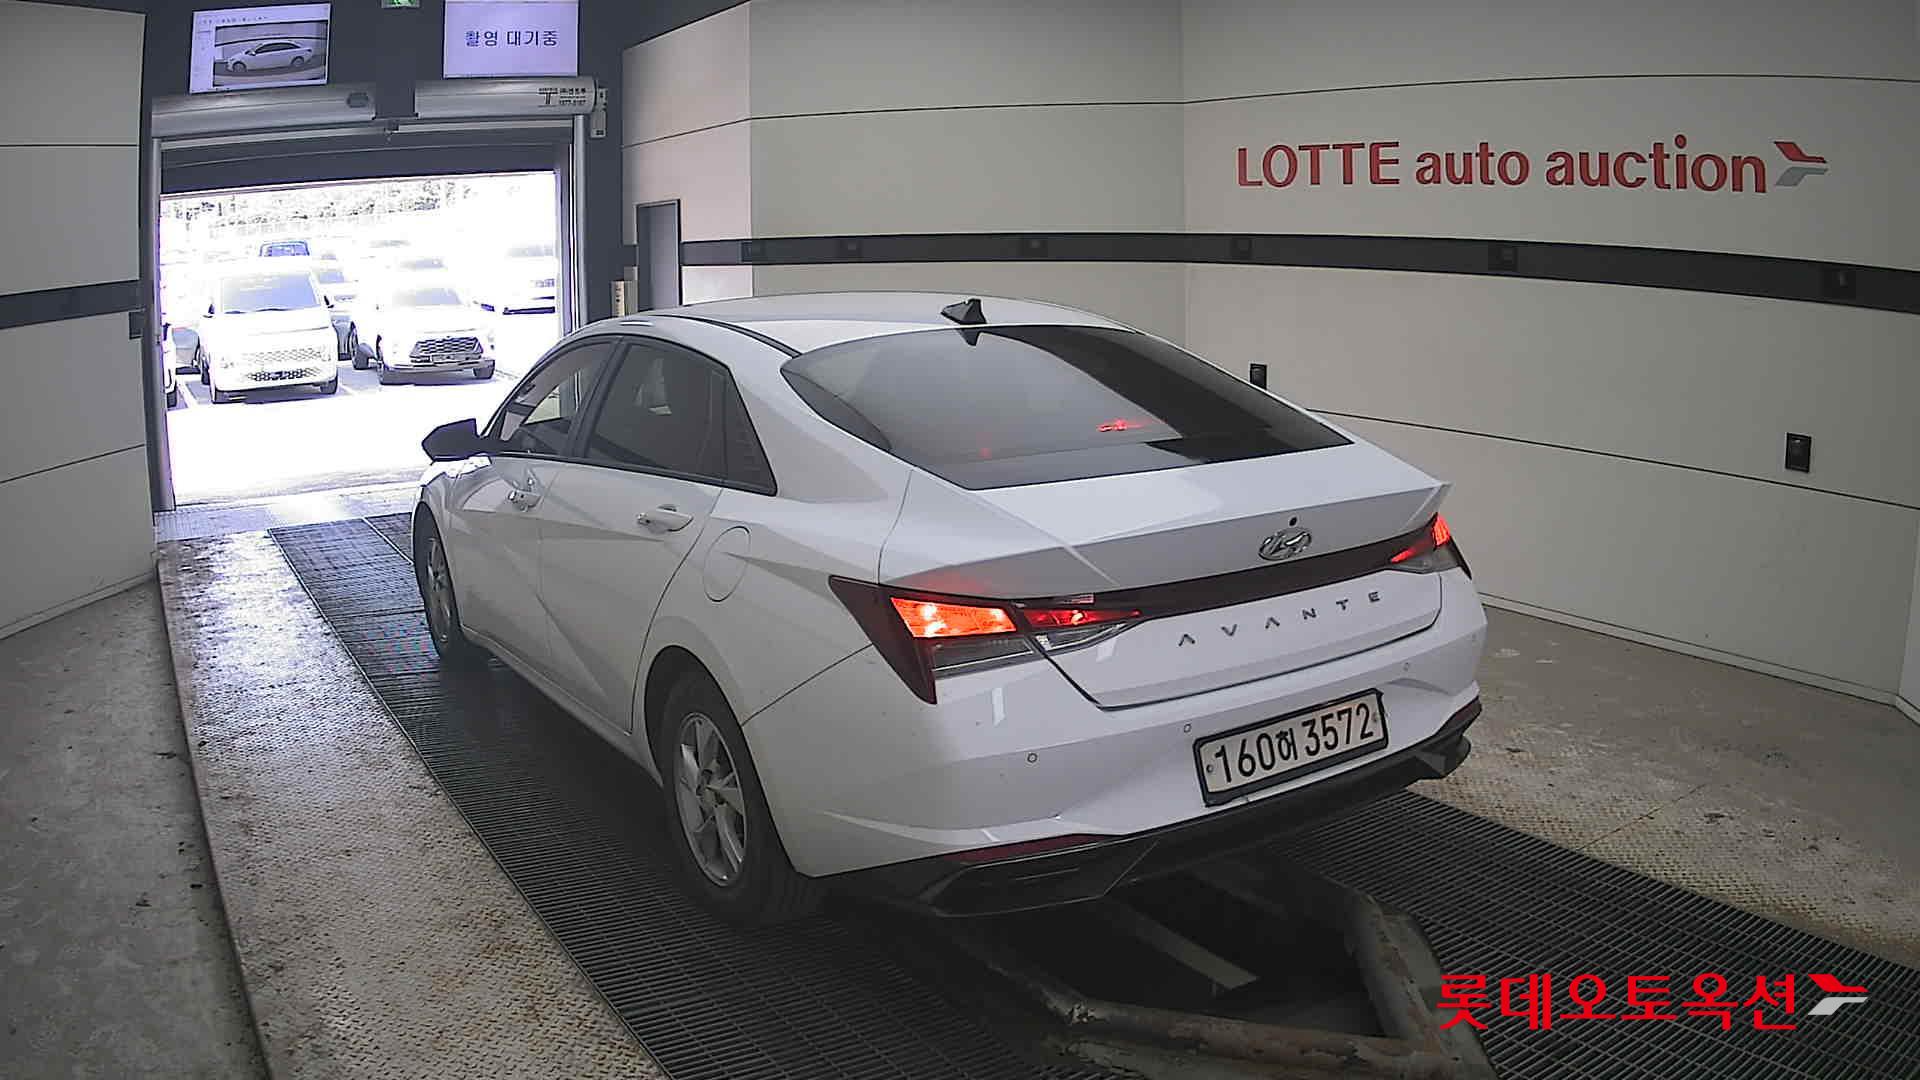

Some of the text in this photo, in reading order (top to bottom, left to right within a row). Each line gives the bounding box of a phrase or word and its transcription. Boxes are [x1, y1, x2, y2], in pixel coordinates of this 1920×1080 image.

[465, 30, 557, 47] 촬영 대기중
[1237, 134, 1766, 193] LOTTE auto auction
[1178, 591, 1381, 647] AVANTE
